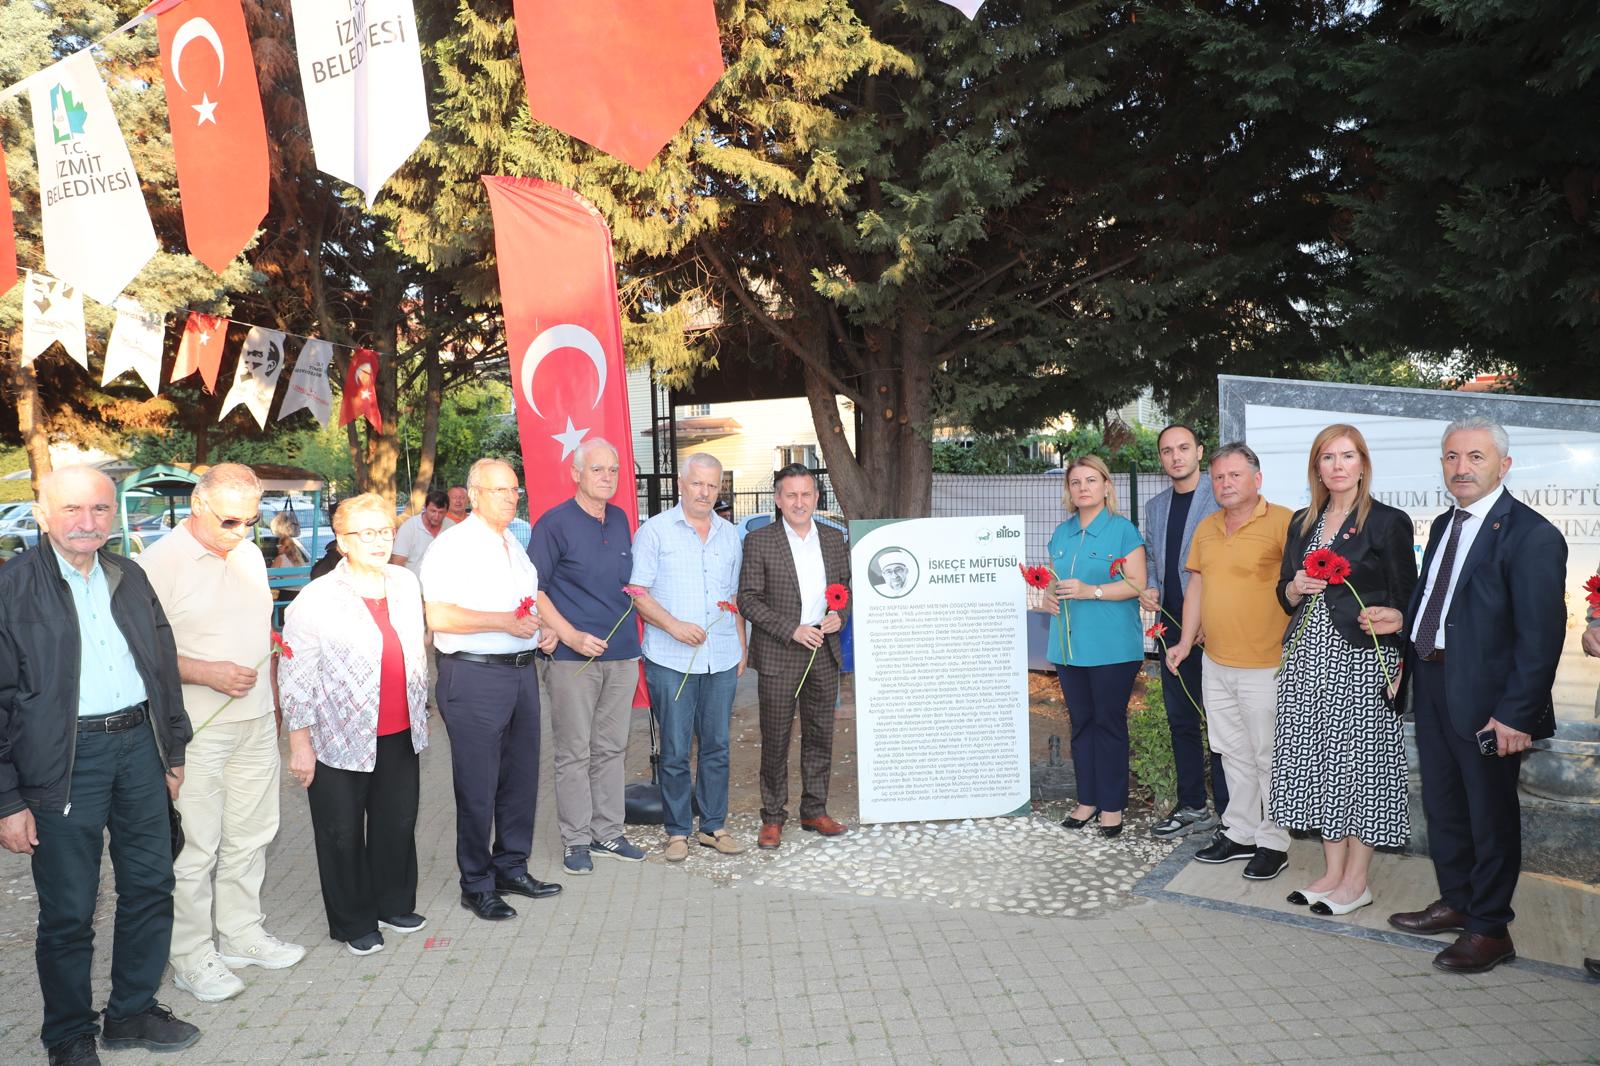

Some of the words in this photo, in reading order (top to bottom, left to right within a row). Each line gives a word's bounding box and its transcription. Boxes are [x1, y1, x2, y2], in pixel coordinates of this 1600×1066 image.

[62, 142, 87, 155] T.C.
[56, 154, 102, 179] İZMİT
[46, 168, 132, 206] BELEDİYESİ
[928, 558, 966, 571] İSKEÇE
[970, 556, 1018, 568] MÜFTÜSÜ
[928, 574, 966, 584] AHMET
[970, 572, 996, 583] METE
